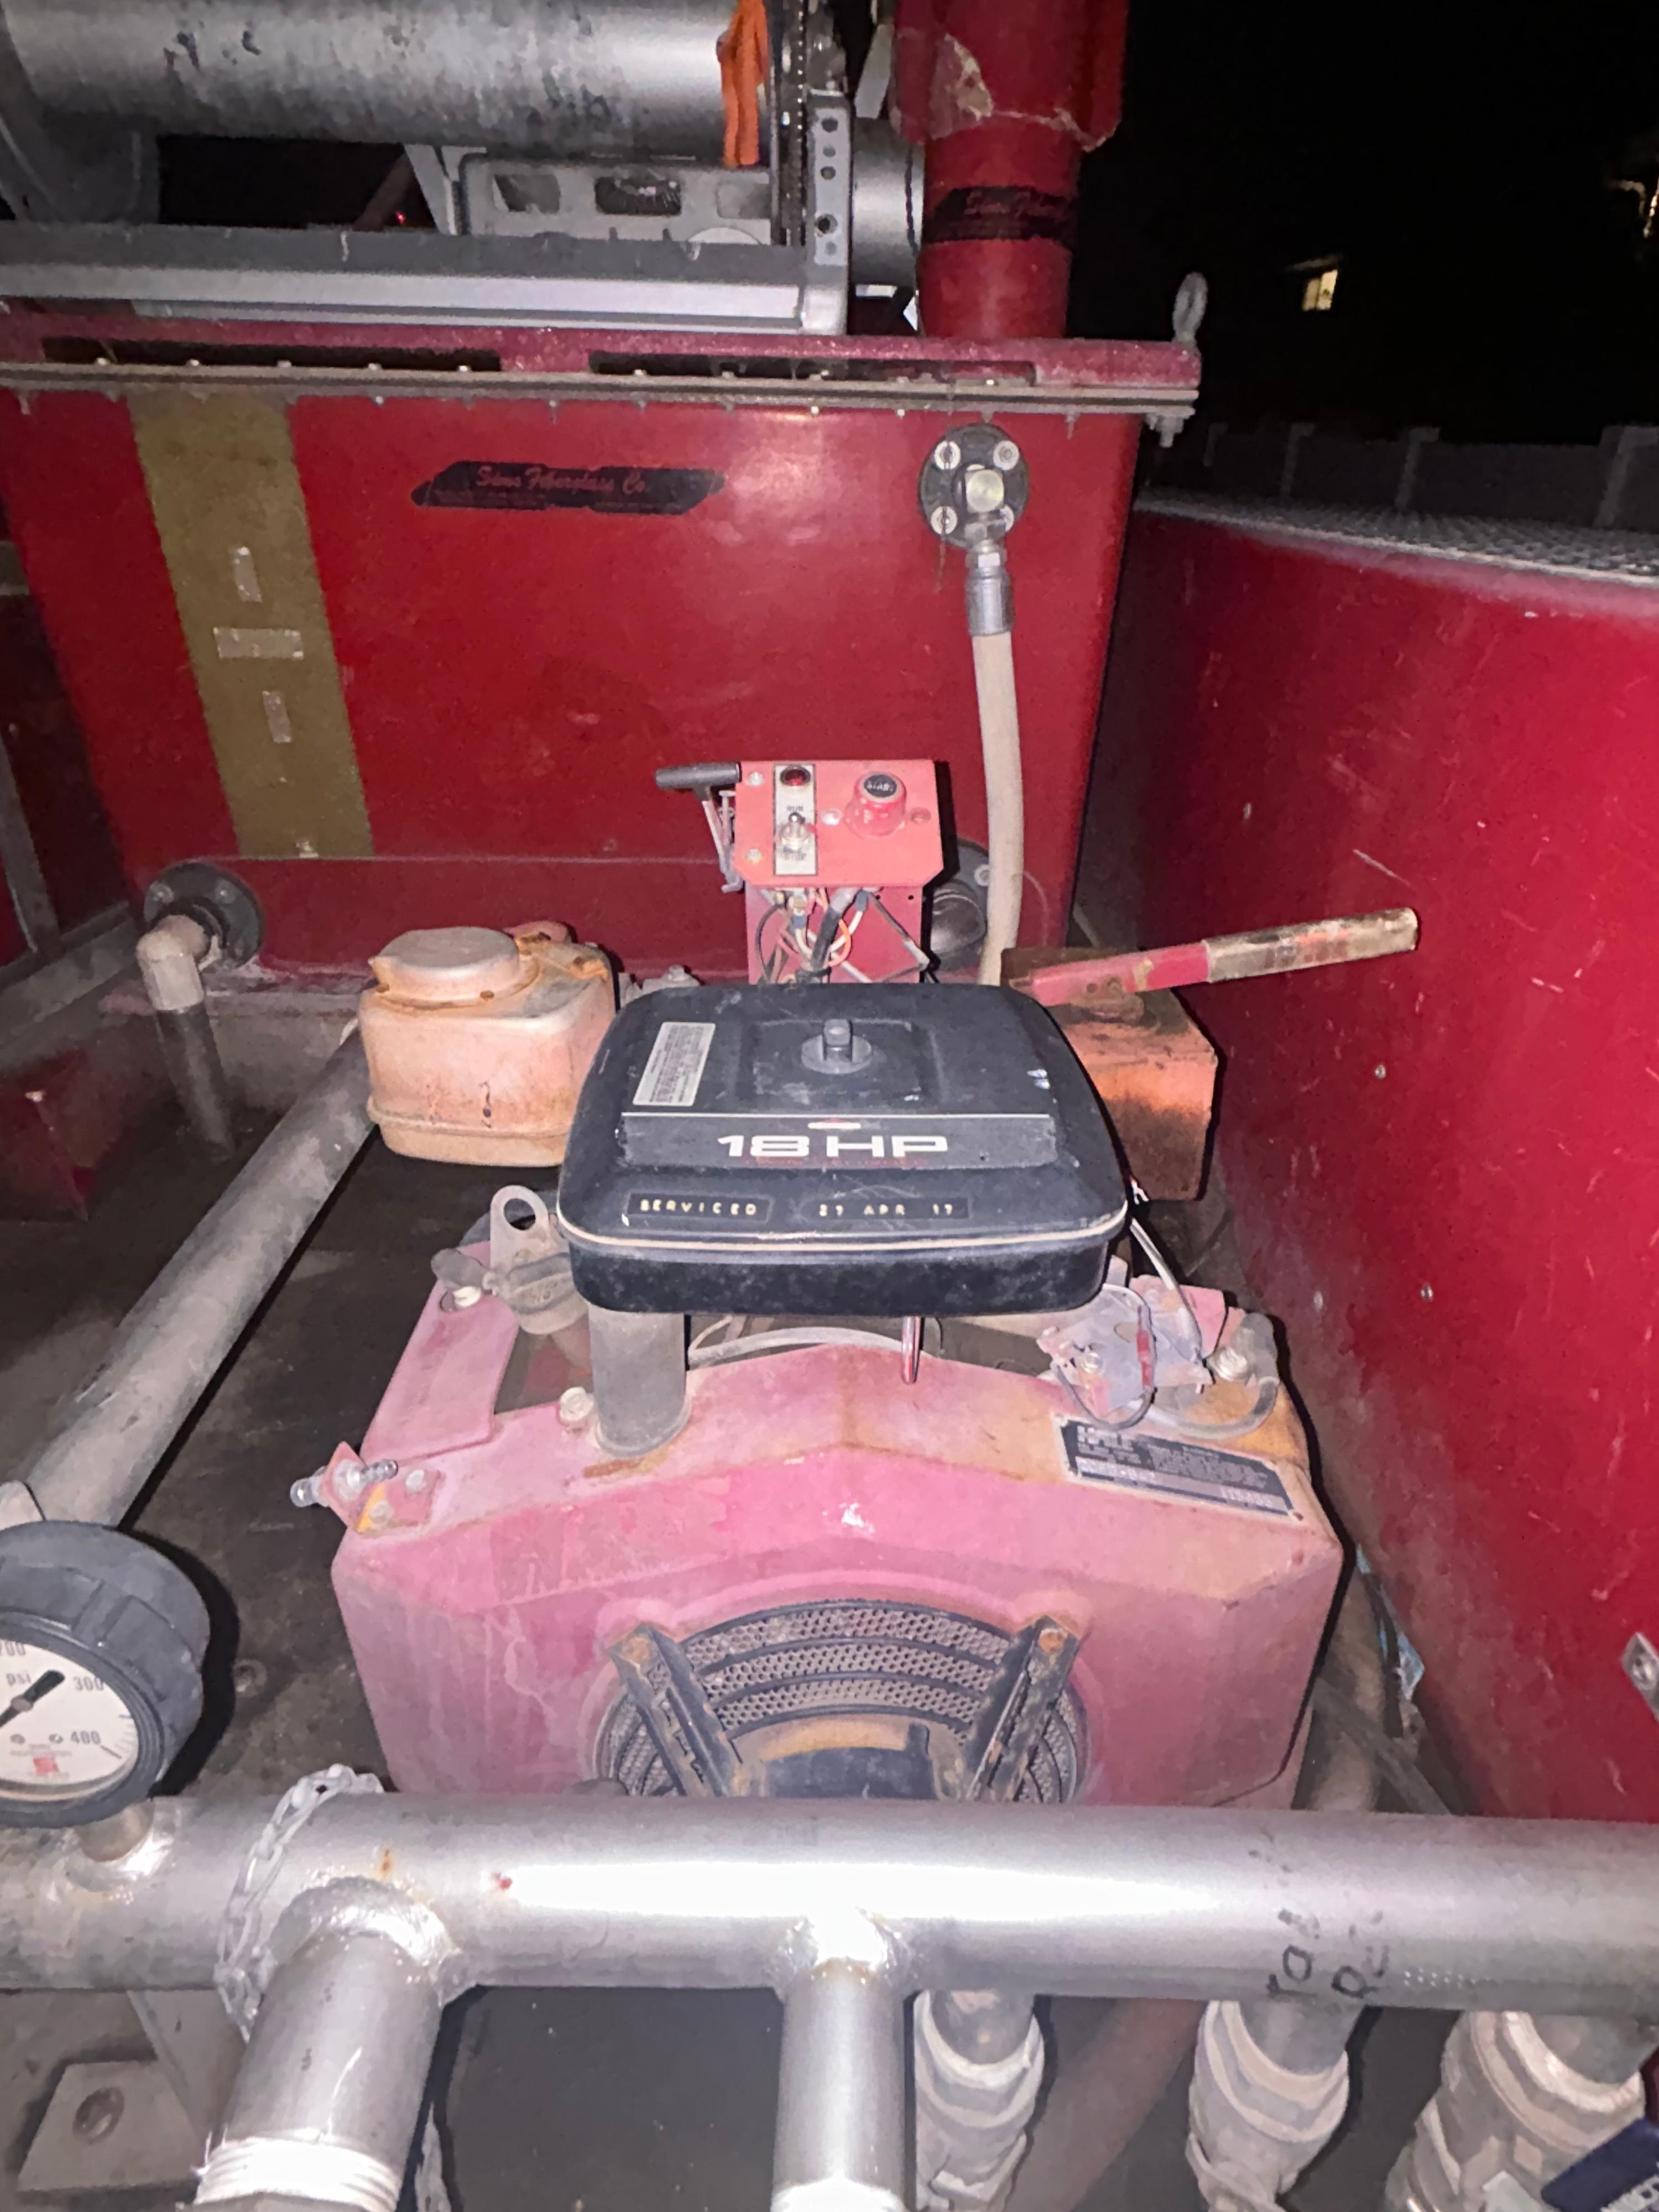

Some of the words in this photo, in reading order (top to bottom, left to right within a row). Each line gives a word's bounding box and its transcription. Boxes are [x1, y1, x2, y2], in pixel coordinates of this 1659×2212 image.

[640, 1199, 757, 1215] SERVICED
[864, 1204, 905, 1215] APR
[0, 1640, 26, 1656] 00
[73, 1677, 104, 1691] 300
[71, 1731, 101, 1744] 400
